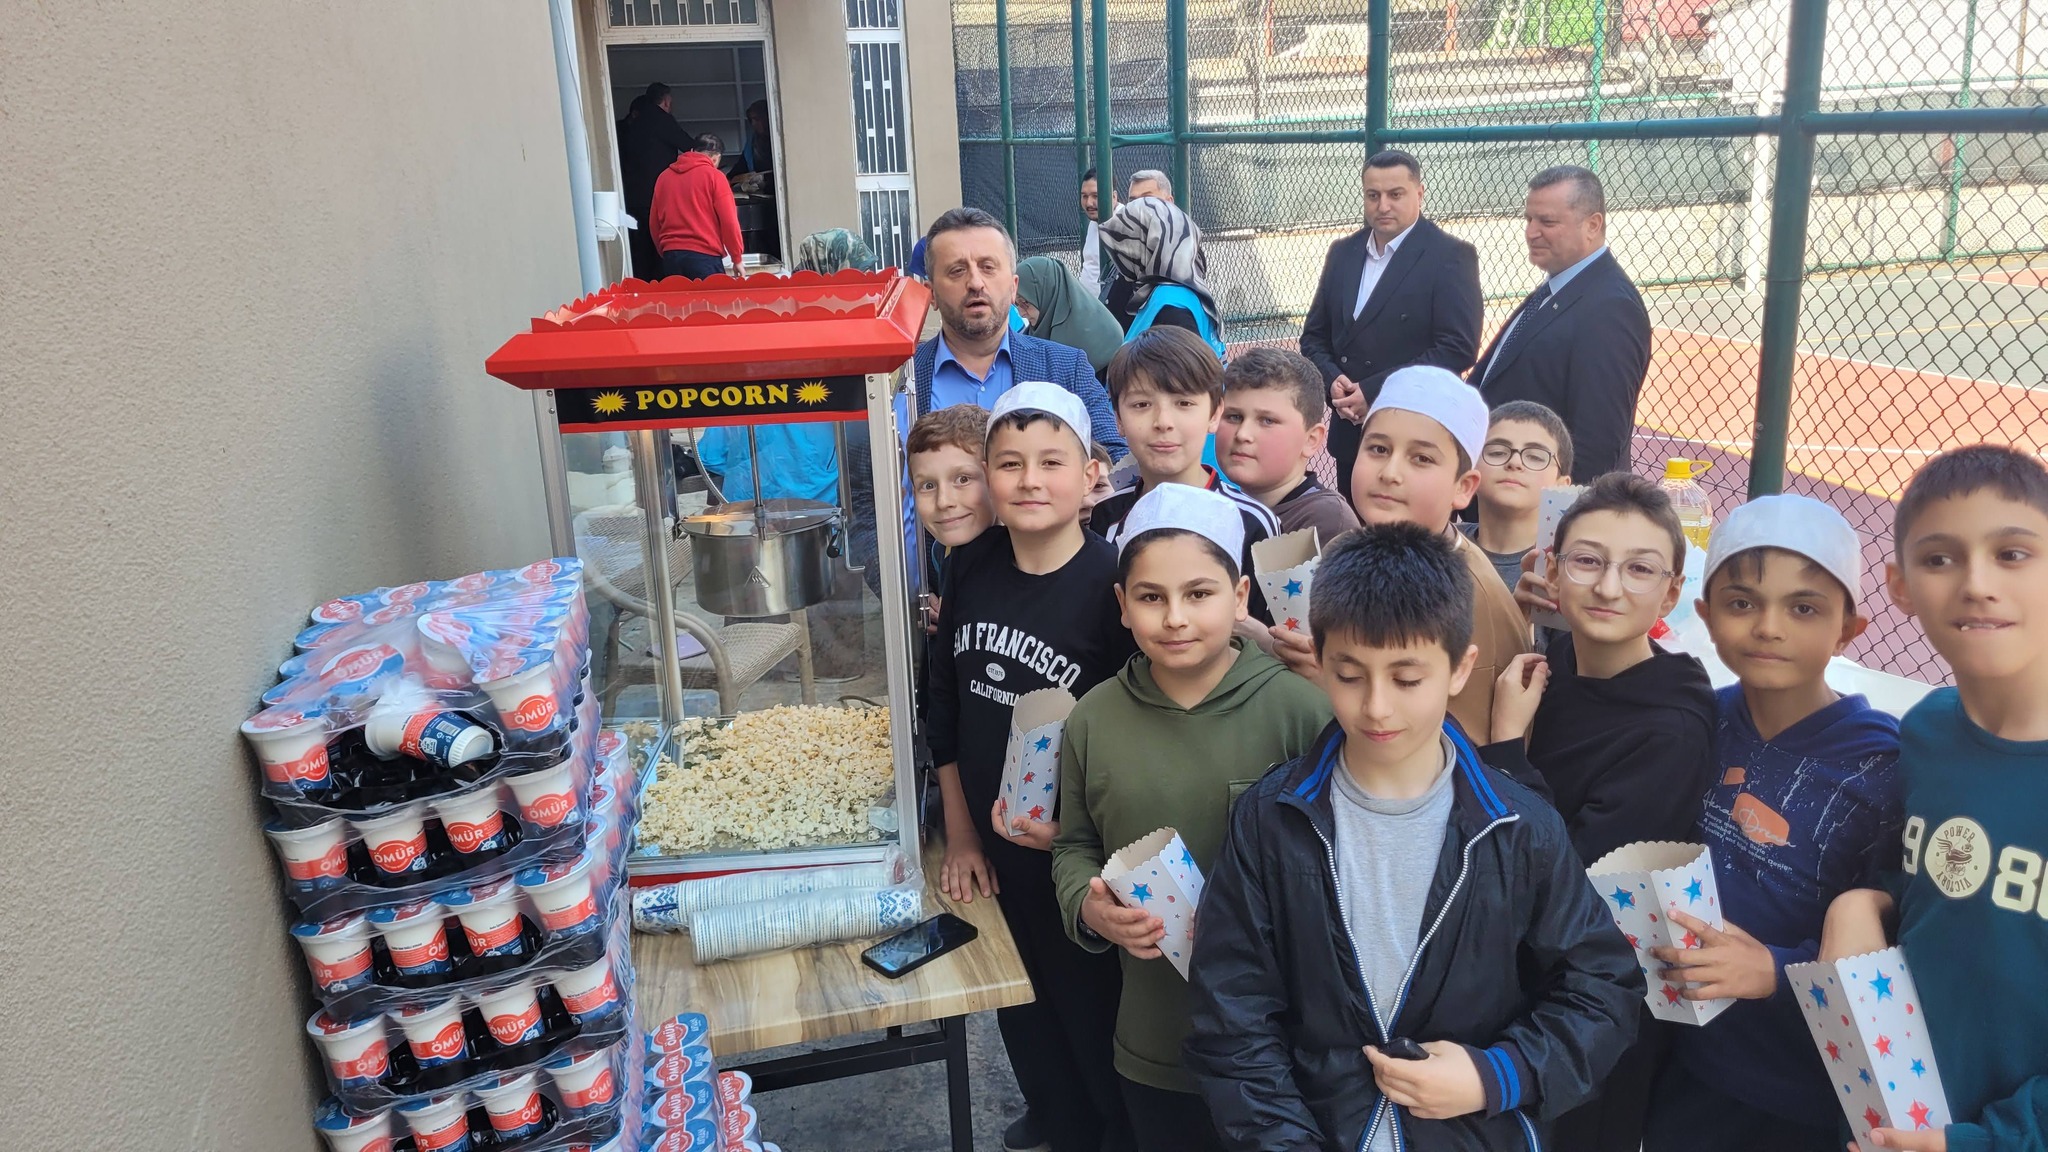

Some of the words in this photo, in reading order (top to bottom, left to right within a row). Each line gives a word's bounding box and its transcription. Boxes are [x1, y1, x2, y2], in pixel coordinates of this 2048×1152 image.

[635, 383, 789, 411] POPCORN
[975, 622, 1081, 689] FRANCISCO
[513, 701, 554, 725] ÖMÜR
[529, 799, 569, 820] ÖMÜR
[1944, 825, 1975, 843] POWER
[374, 844, 415, 864] ÖMÜR
[1936, 871, 1972, 893] VICTORY
[489, 1018, 526, 1036] ÖMÜR
[664, 1022, 676, 1047] ÖMÜR
[667, 1055, 679, 1081] ÖMÜR
[721, 1077, 735, 1101] ÖMÜR
[668, 1093, 681, 1120] ÖMÜR
[728, 1109, 740, 1136] ÖMÜR
